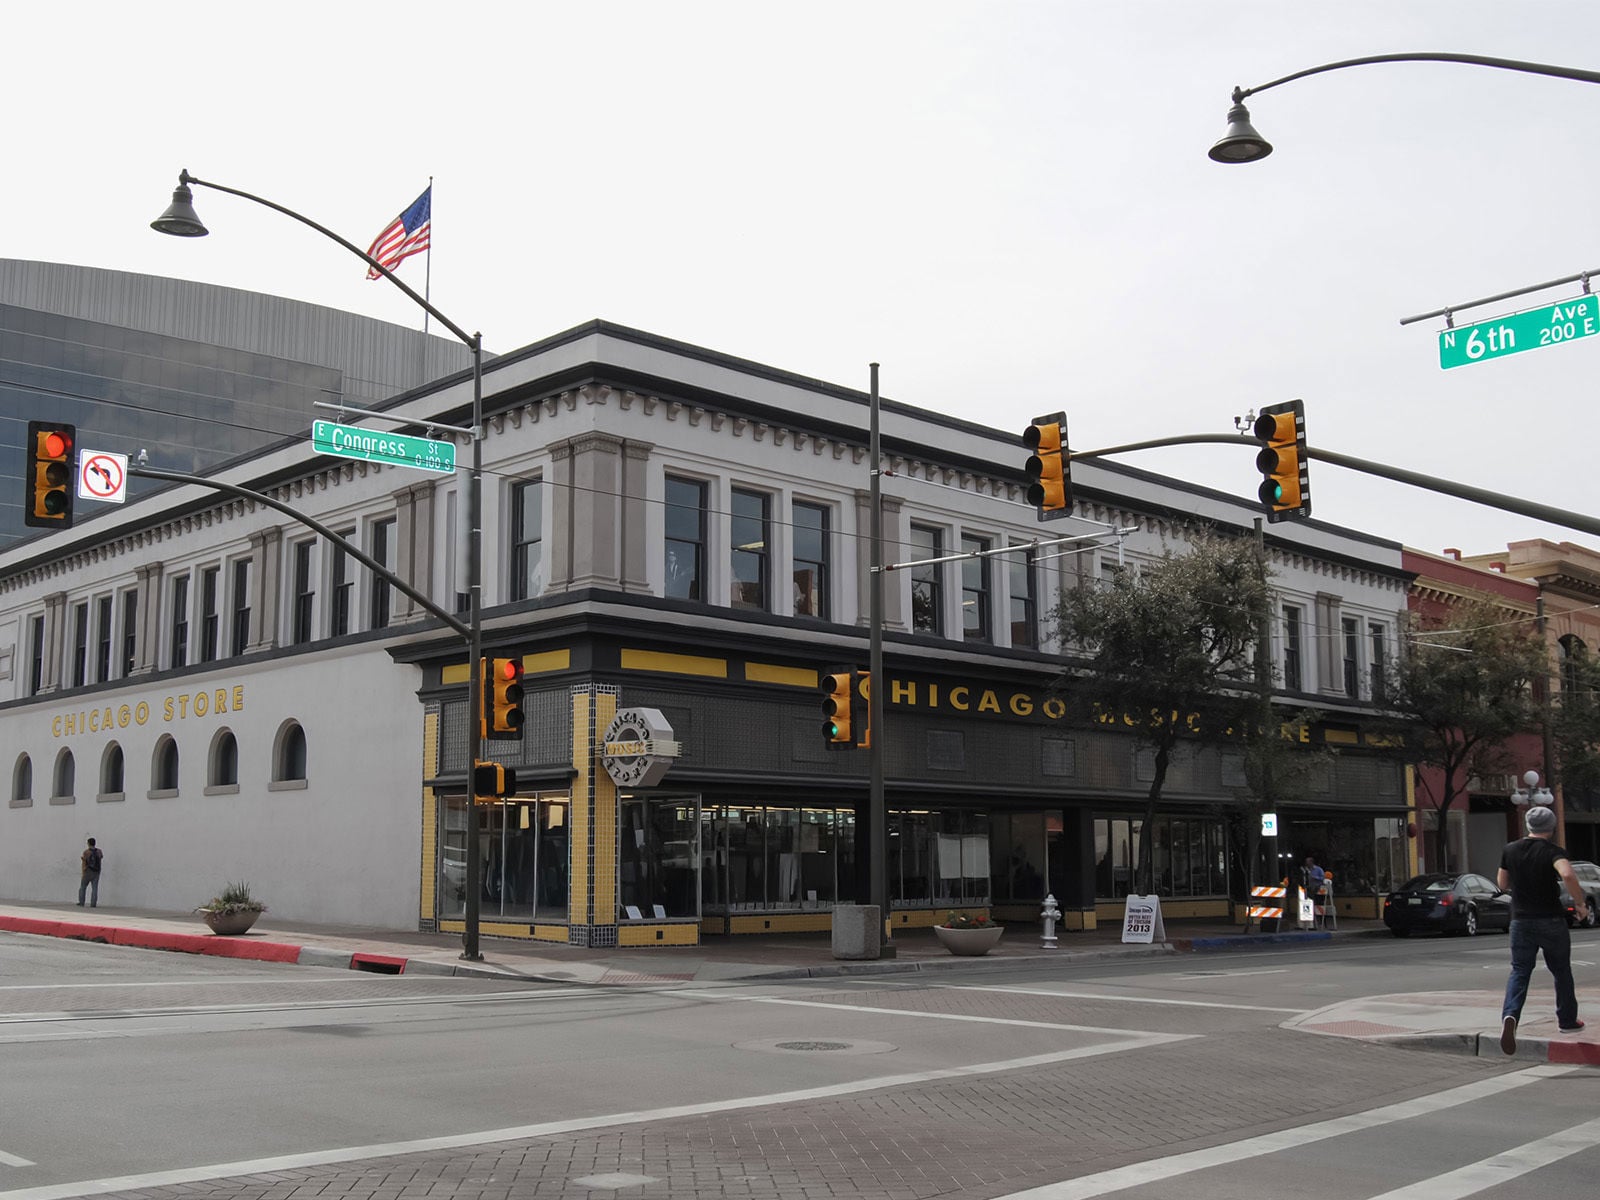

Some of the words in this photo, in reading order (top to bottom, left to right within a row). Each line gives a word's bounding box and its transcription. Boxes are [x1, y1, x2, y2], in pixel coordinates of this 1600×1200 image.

[1551, 303, 1587, 323] Ave
[1444, 332, 1455, 348] N
[1466, 324, 1516, 359] 6th
[1540, 322, 1575, 345] 200
[1584, 317, 1595, 335] E
[318, 424, 325, 437] E
[332, 428, 406, 459] Congress
[428, 443, 439, 455] St
[445, 458, 451, 471] S
[52, 701, 150, 737] CHICAGO
[163, 685, 244, 721] STORE
[1093, 702, 1200, 732] USIC
[605, 711, 650, 742] CHICAGO
[1127, 924, 1150, 932] 2013
